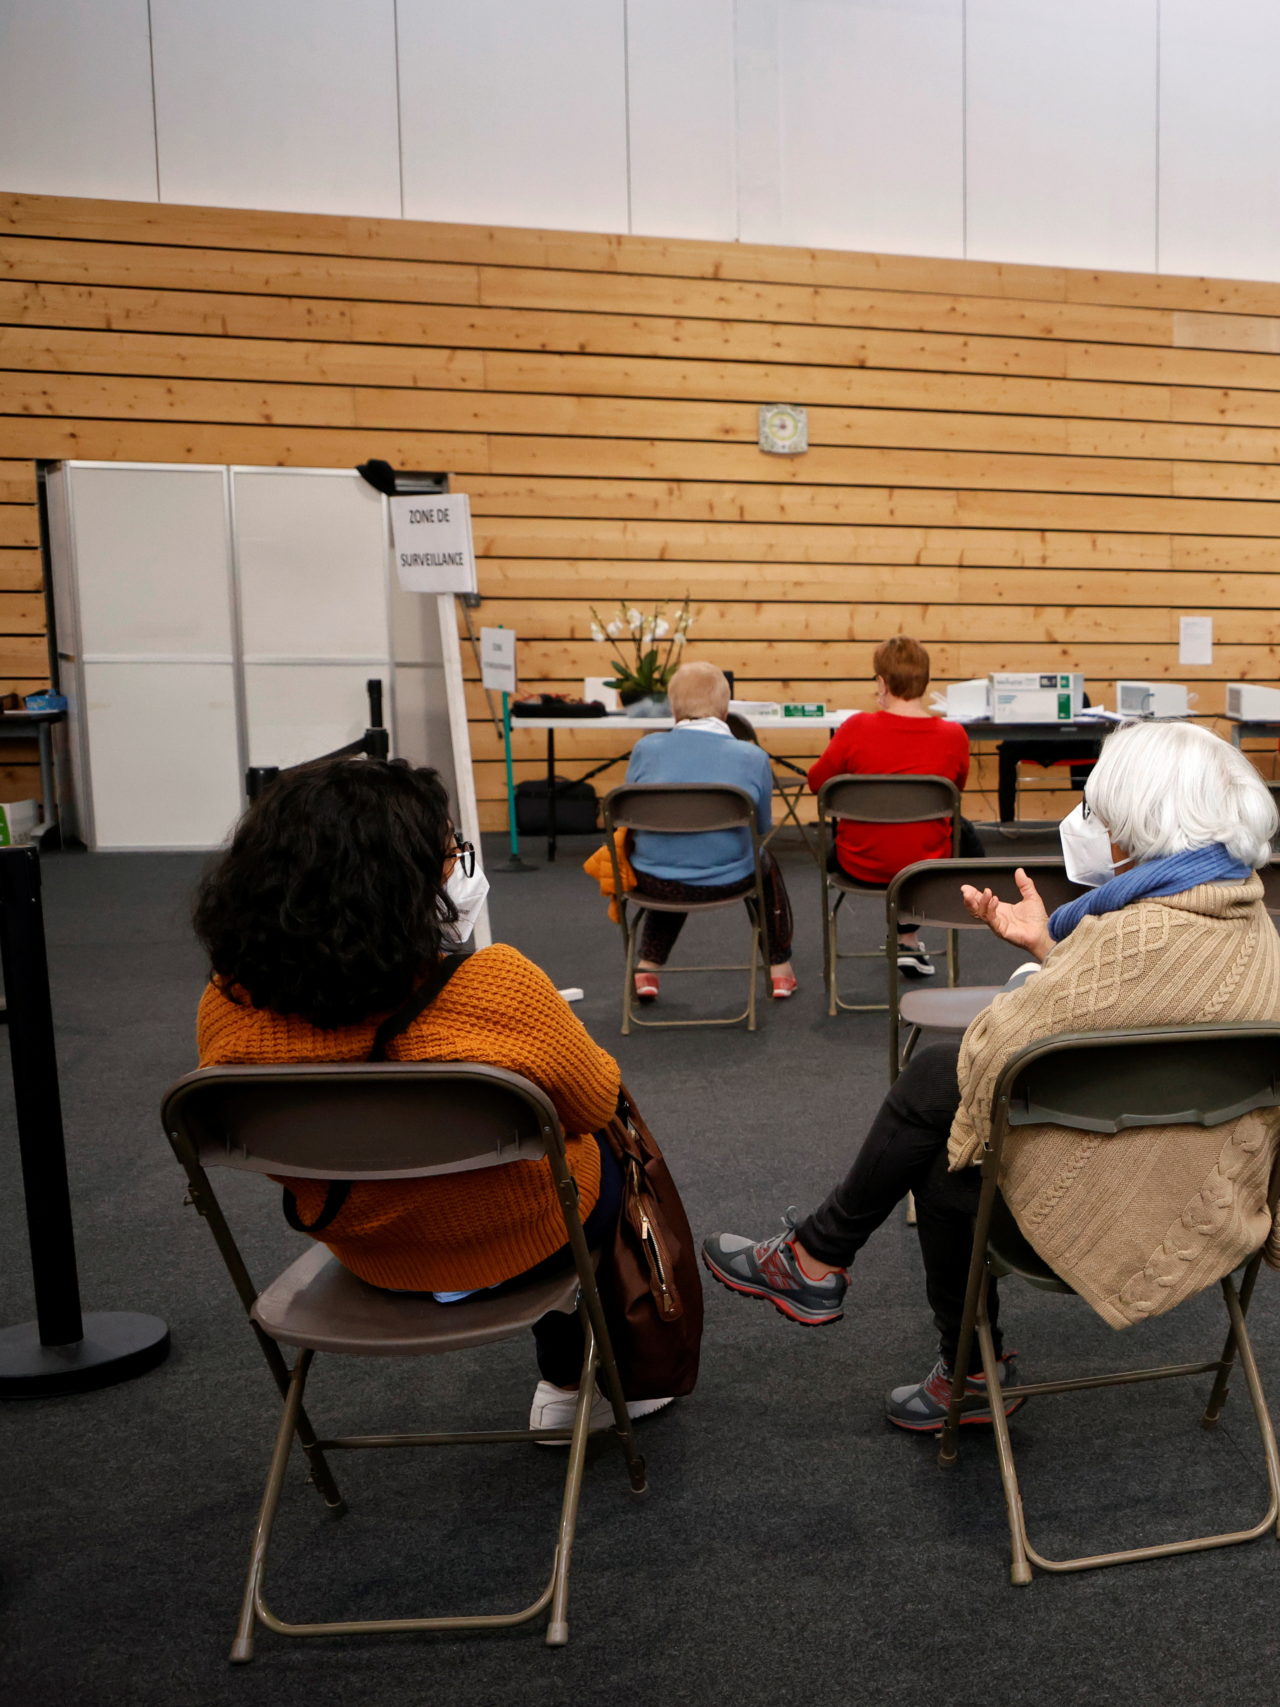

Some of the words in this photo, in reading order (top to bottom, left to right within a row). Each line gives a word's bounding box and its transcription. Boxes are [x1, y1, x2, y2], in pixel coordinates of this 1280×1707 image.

[409, 509, 434, 524] ZONE
[437, 508, 450, 523] DE
[401, 552, 464, 567] SURVEILLANCE
